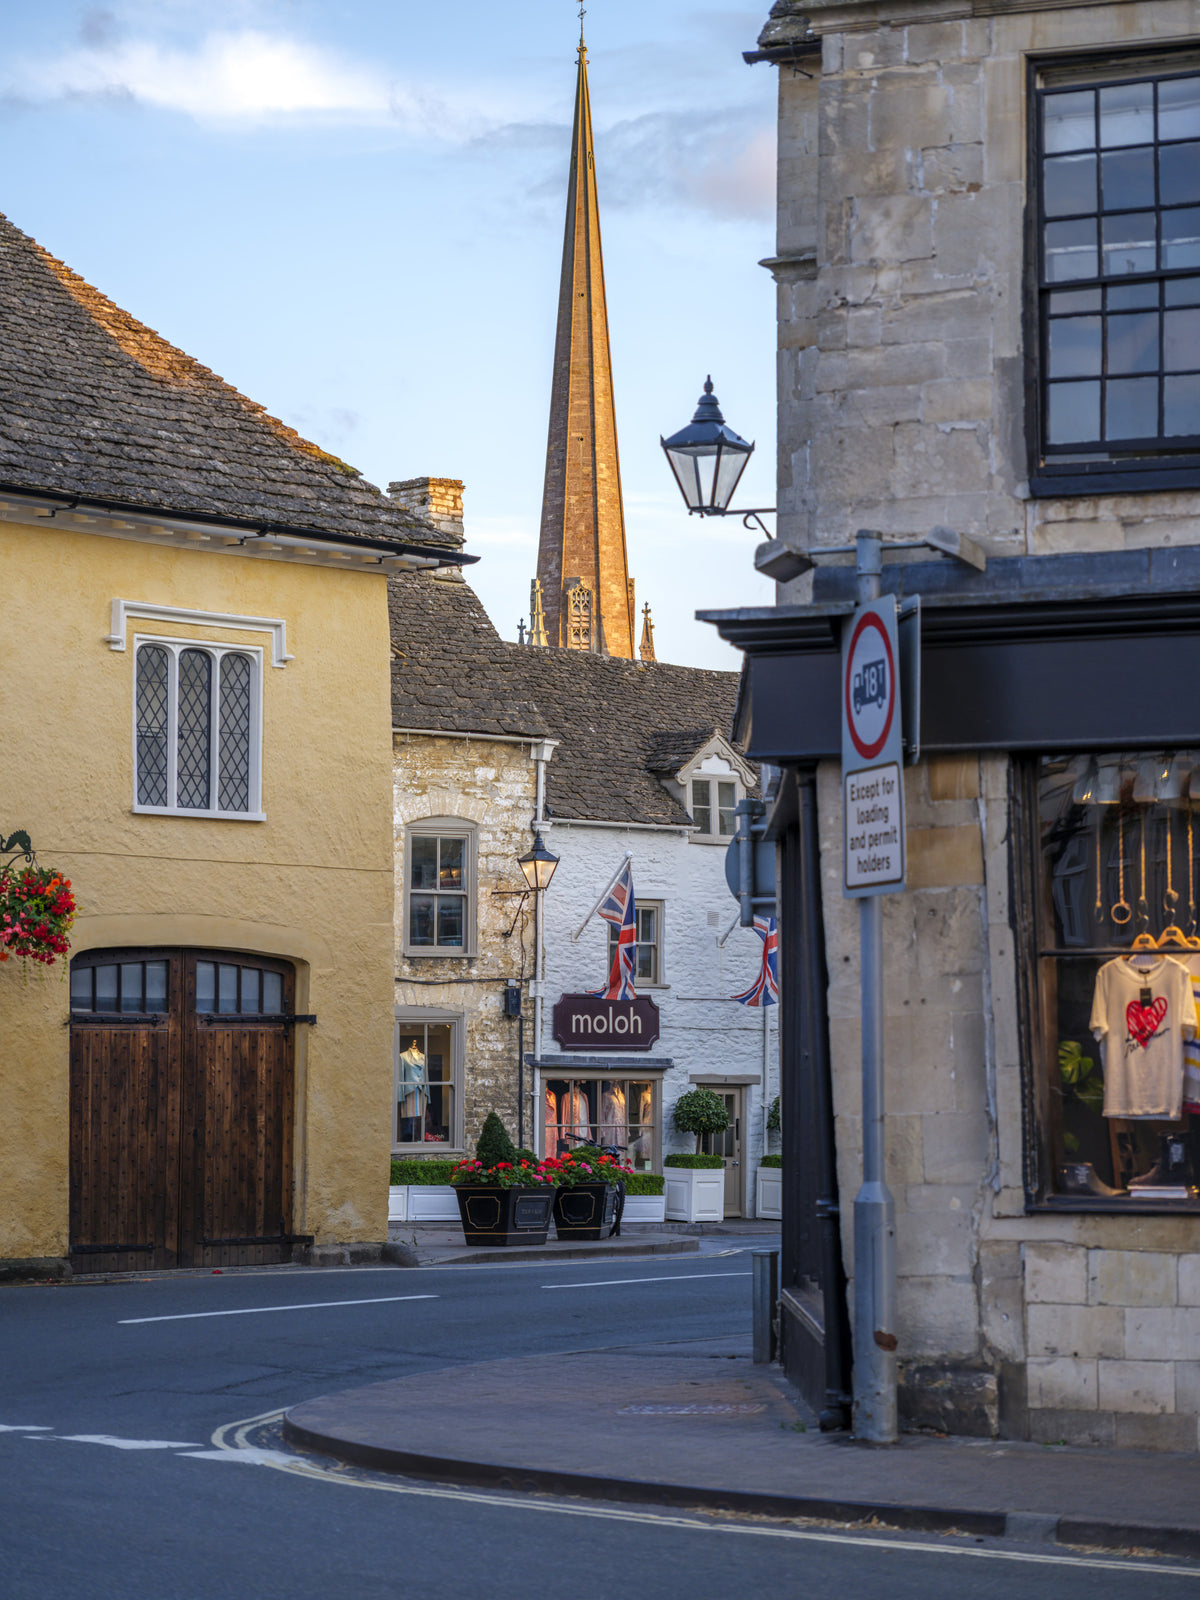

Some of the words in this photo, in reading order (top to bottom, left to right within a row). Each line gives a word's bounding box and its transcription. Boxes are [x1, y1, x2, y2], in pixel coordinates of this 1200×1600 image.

[850, 779, 880, 802] Except
[881, 776, 895, 796] for
[856, 803, 889, 825] loading
[849, 827, 866, 851] and
[867, 822, 898, 852] permit
[856, 848, 890, 875] holders
[571, 1006, 643, 1034] moloh
